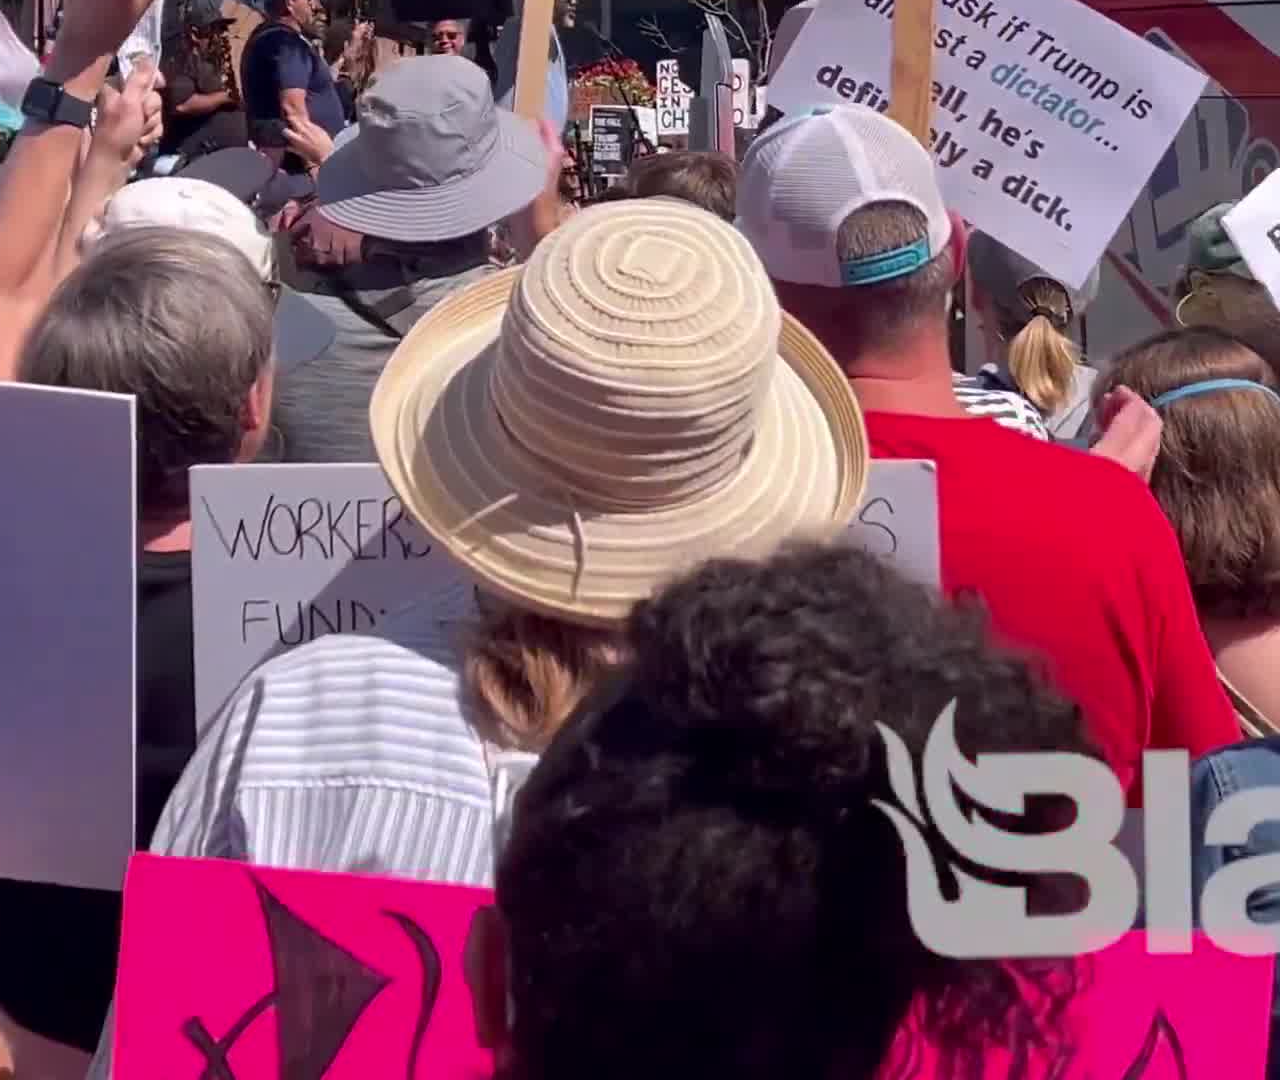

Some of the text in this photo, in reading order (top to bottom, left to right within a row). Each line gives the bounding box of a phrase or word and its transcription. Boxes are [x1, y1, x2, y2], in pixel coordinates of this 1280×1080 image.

[965, 49, 987, 71] a
[990, 62, 1120, 152] dictator...
[997, 15, 1029, 43] if
[1027, 28, 1121, 102] Trump
[1121, 87, 1153, 120] is
[978, 107, 1046, 160] he's
[971, 155, 994, 180] a
[1001, 172, 1073, 232] dick.
